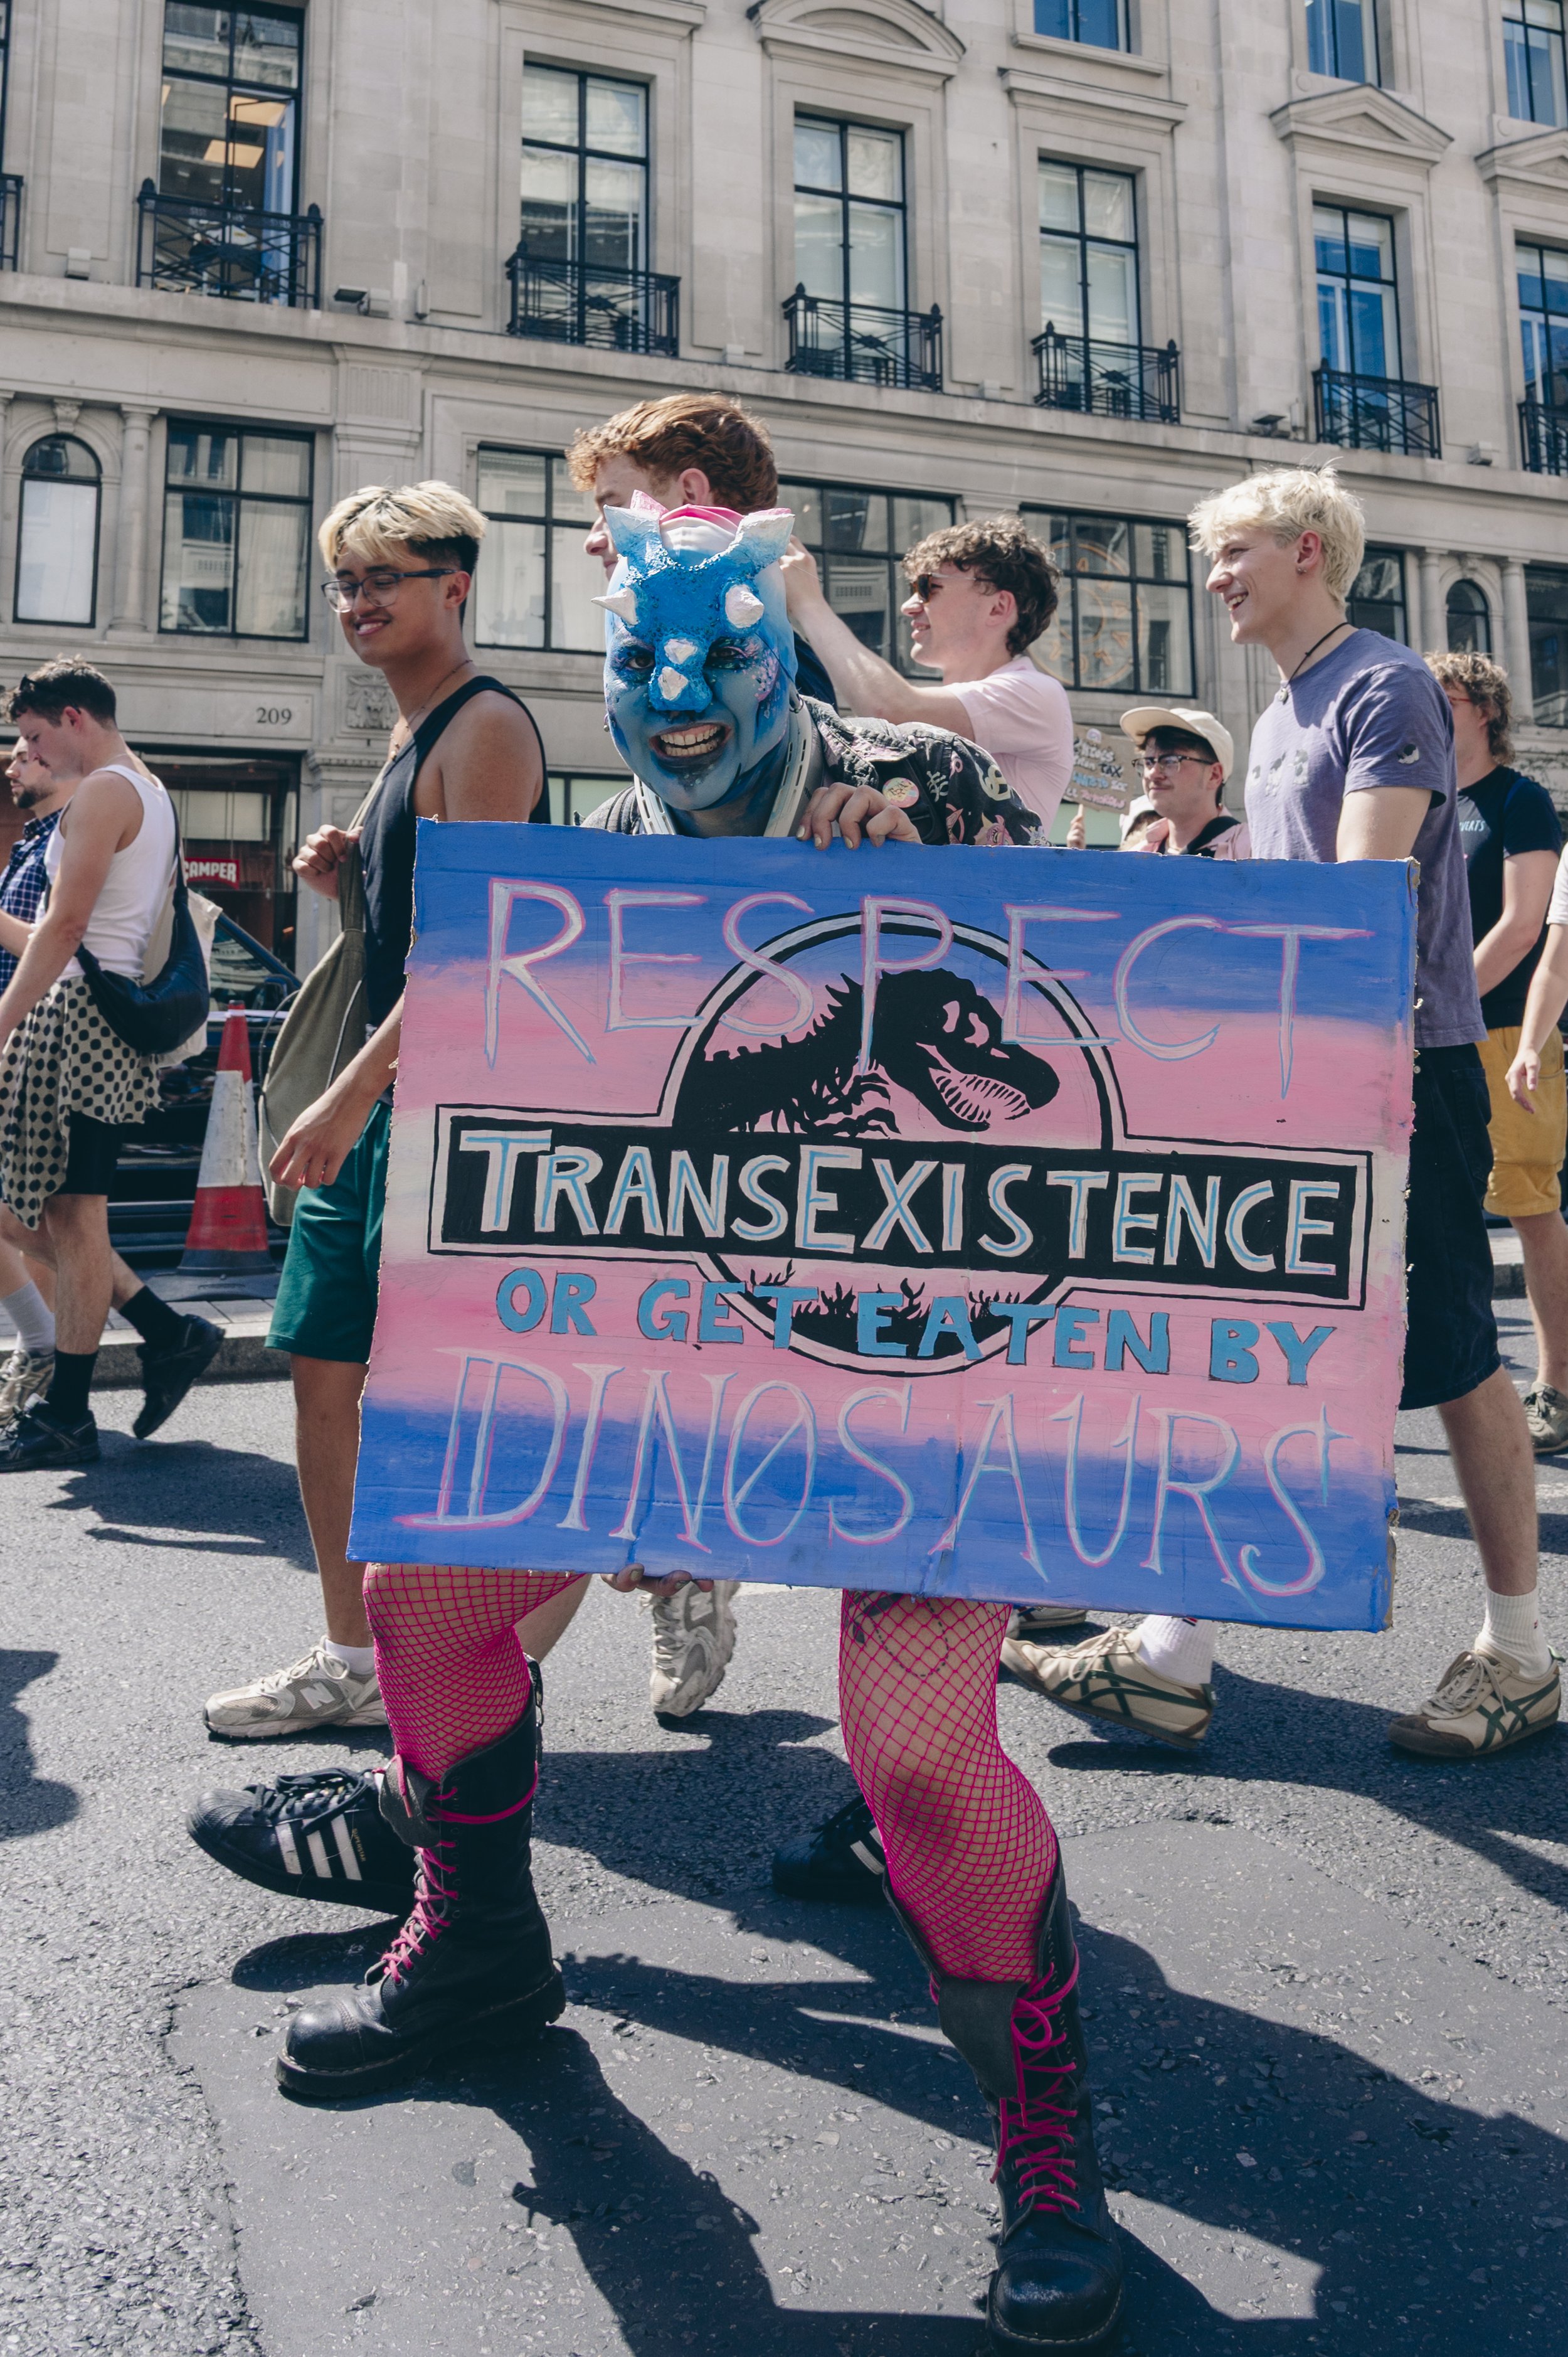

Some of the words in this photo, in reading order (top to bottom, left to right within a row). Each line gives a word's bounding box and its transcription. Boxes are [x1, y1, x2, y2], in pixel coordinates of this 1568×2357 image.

[256, 706, 292, 725] 209
[183, 861, 237, 883] CAMPER
[487, 878, 1371, 1099] RESPECT
[496, 1267, 597, 1336] OR
[637, 1279, 818, 1349] GET
[857, 1292, 1170, 1375] EATEN
[1209, 1317, 1337, 1386] BY
[300, 1681, 336, 1710] N
